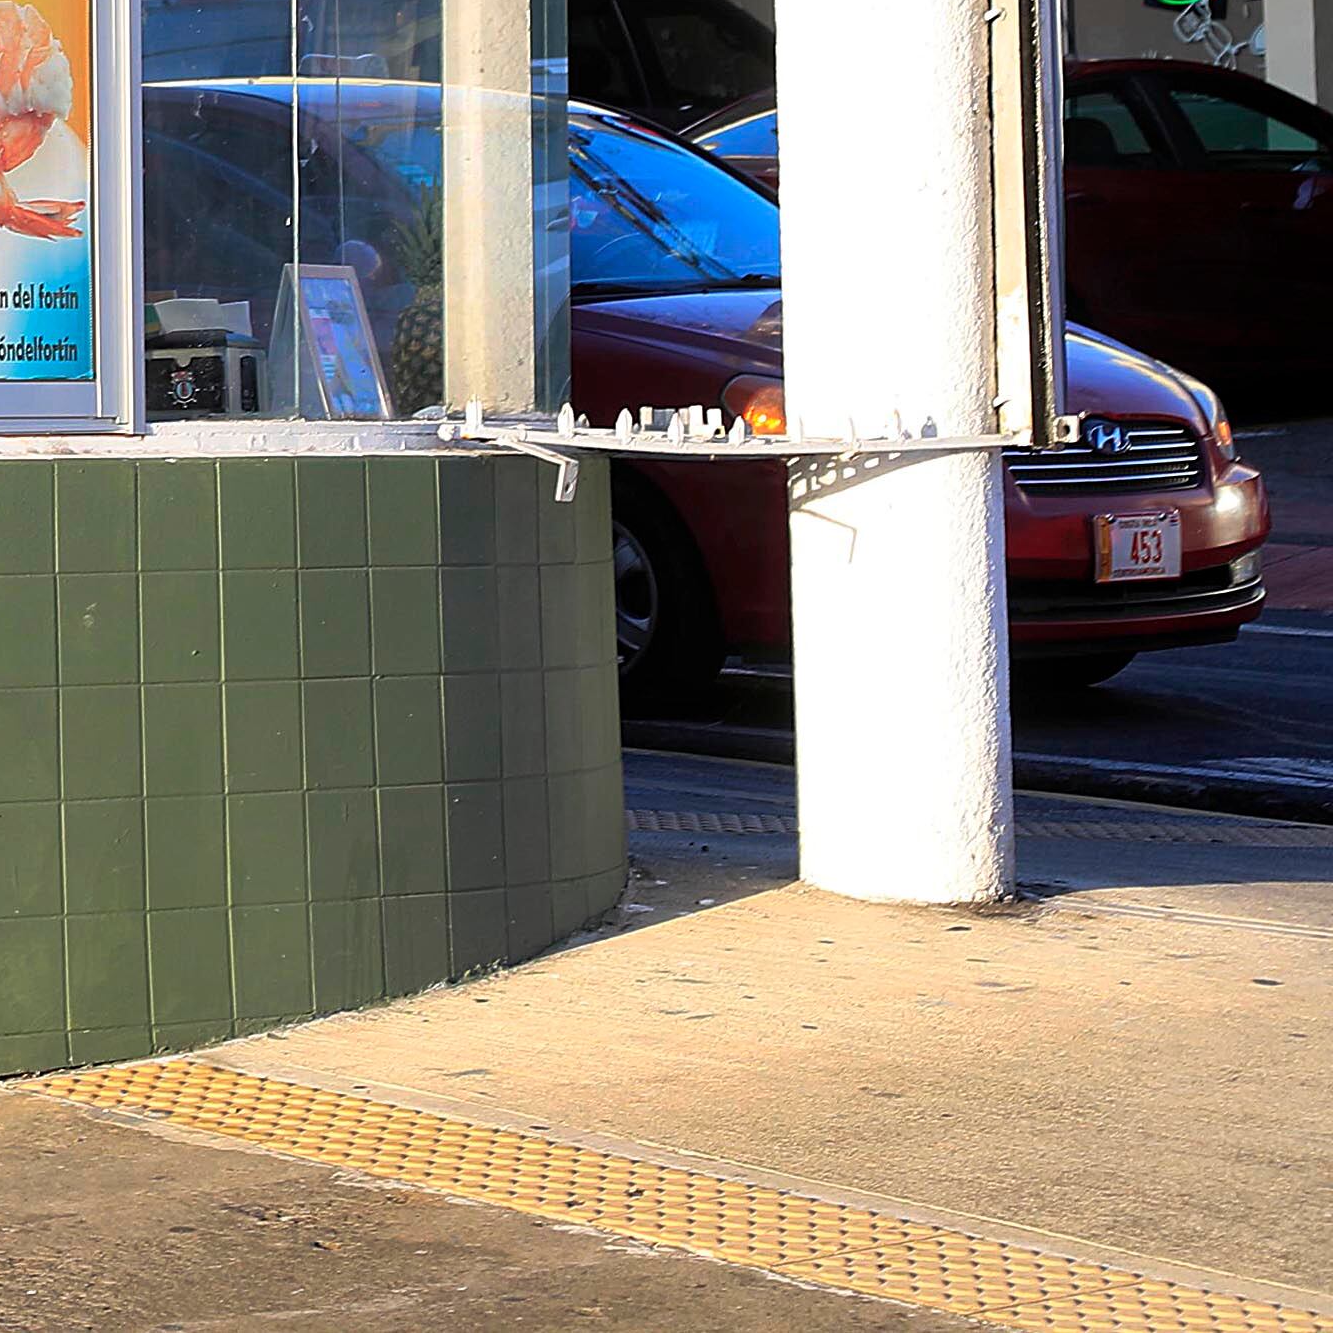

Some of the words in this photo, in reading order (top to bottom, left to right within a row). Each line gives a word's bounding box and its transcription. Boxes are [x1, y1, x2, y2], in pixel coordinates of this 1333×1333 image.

[13, 283, 33, 309] del
[39, 283, 78, 309] fortín
[1131, 530, 1162, 564] 453
